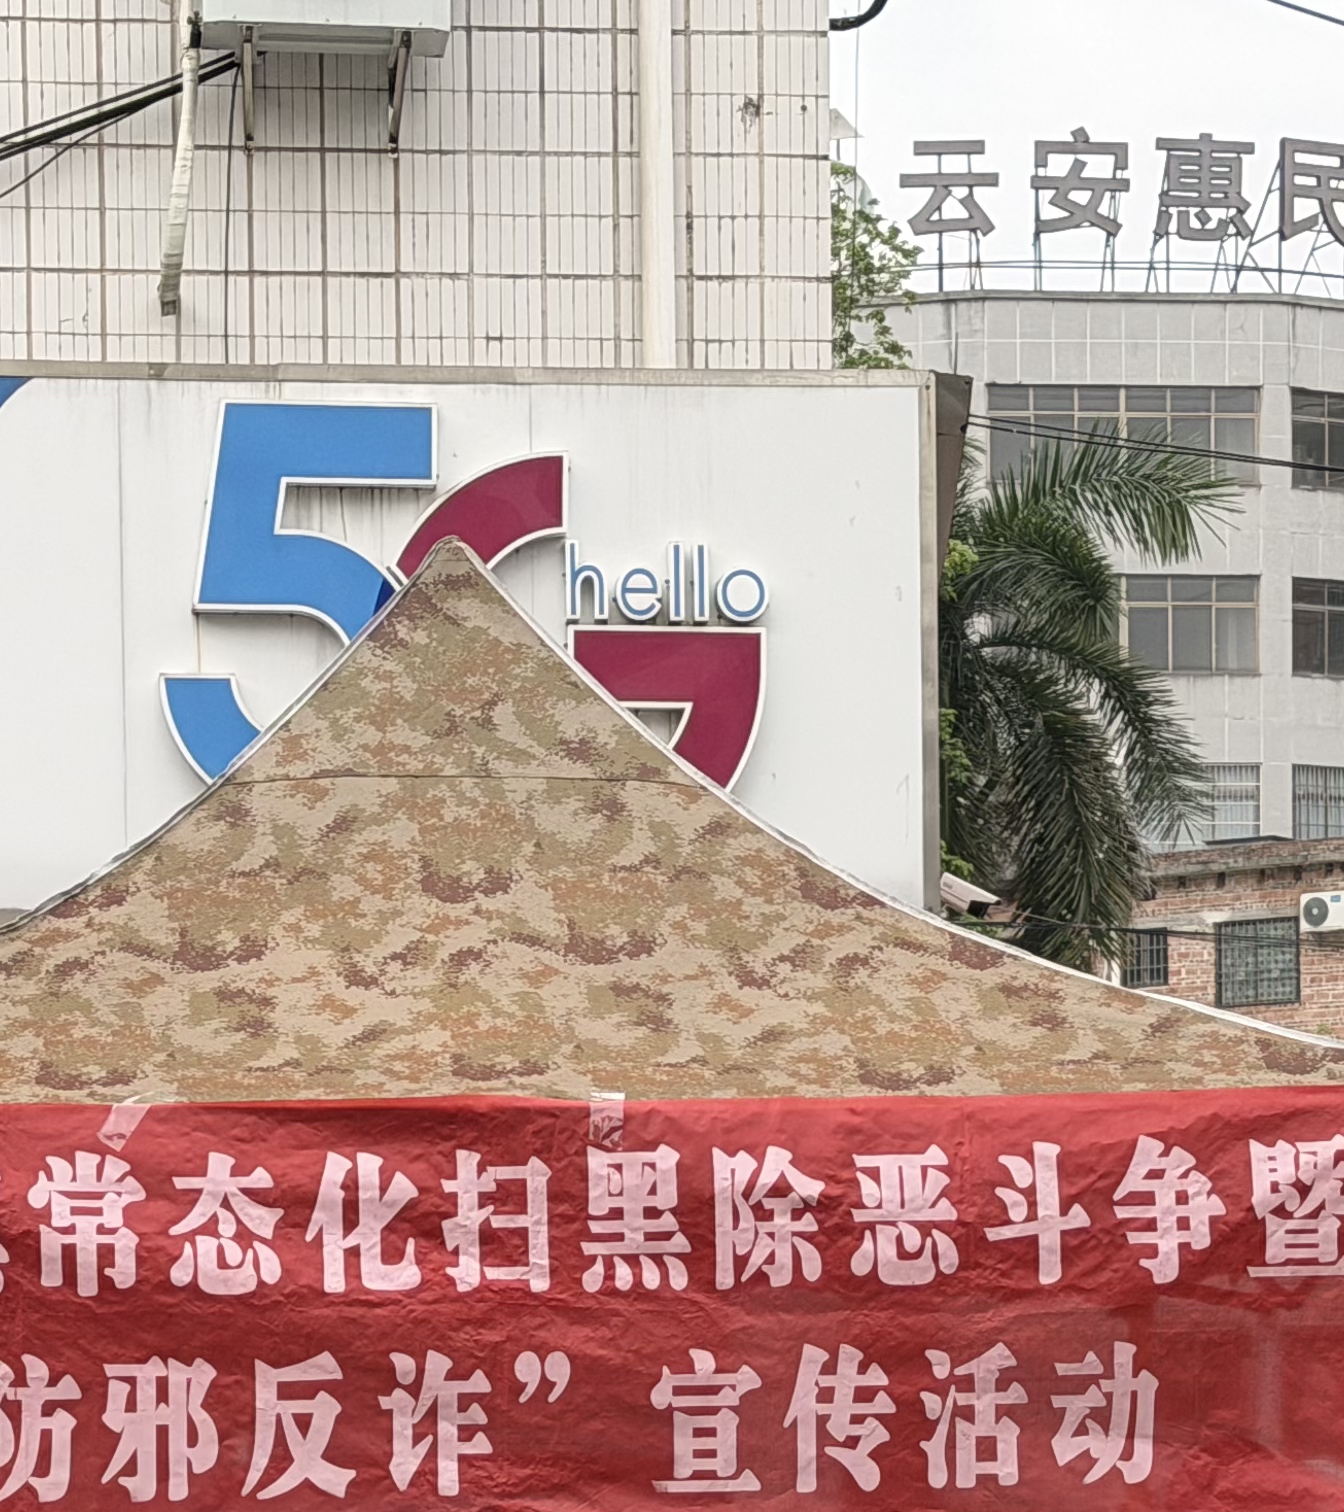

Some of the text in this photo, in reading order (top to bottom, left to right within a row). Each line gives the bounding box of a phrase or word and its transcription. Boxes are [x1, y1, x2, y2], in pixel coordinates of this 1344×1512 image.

[565, 540, 768, 622] hello
[649, 1340, 1160, 1493] 宣传活动
